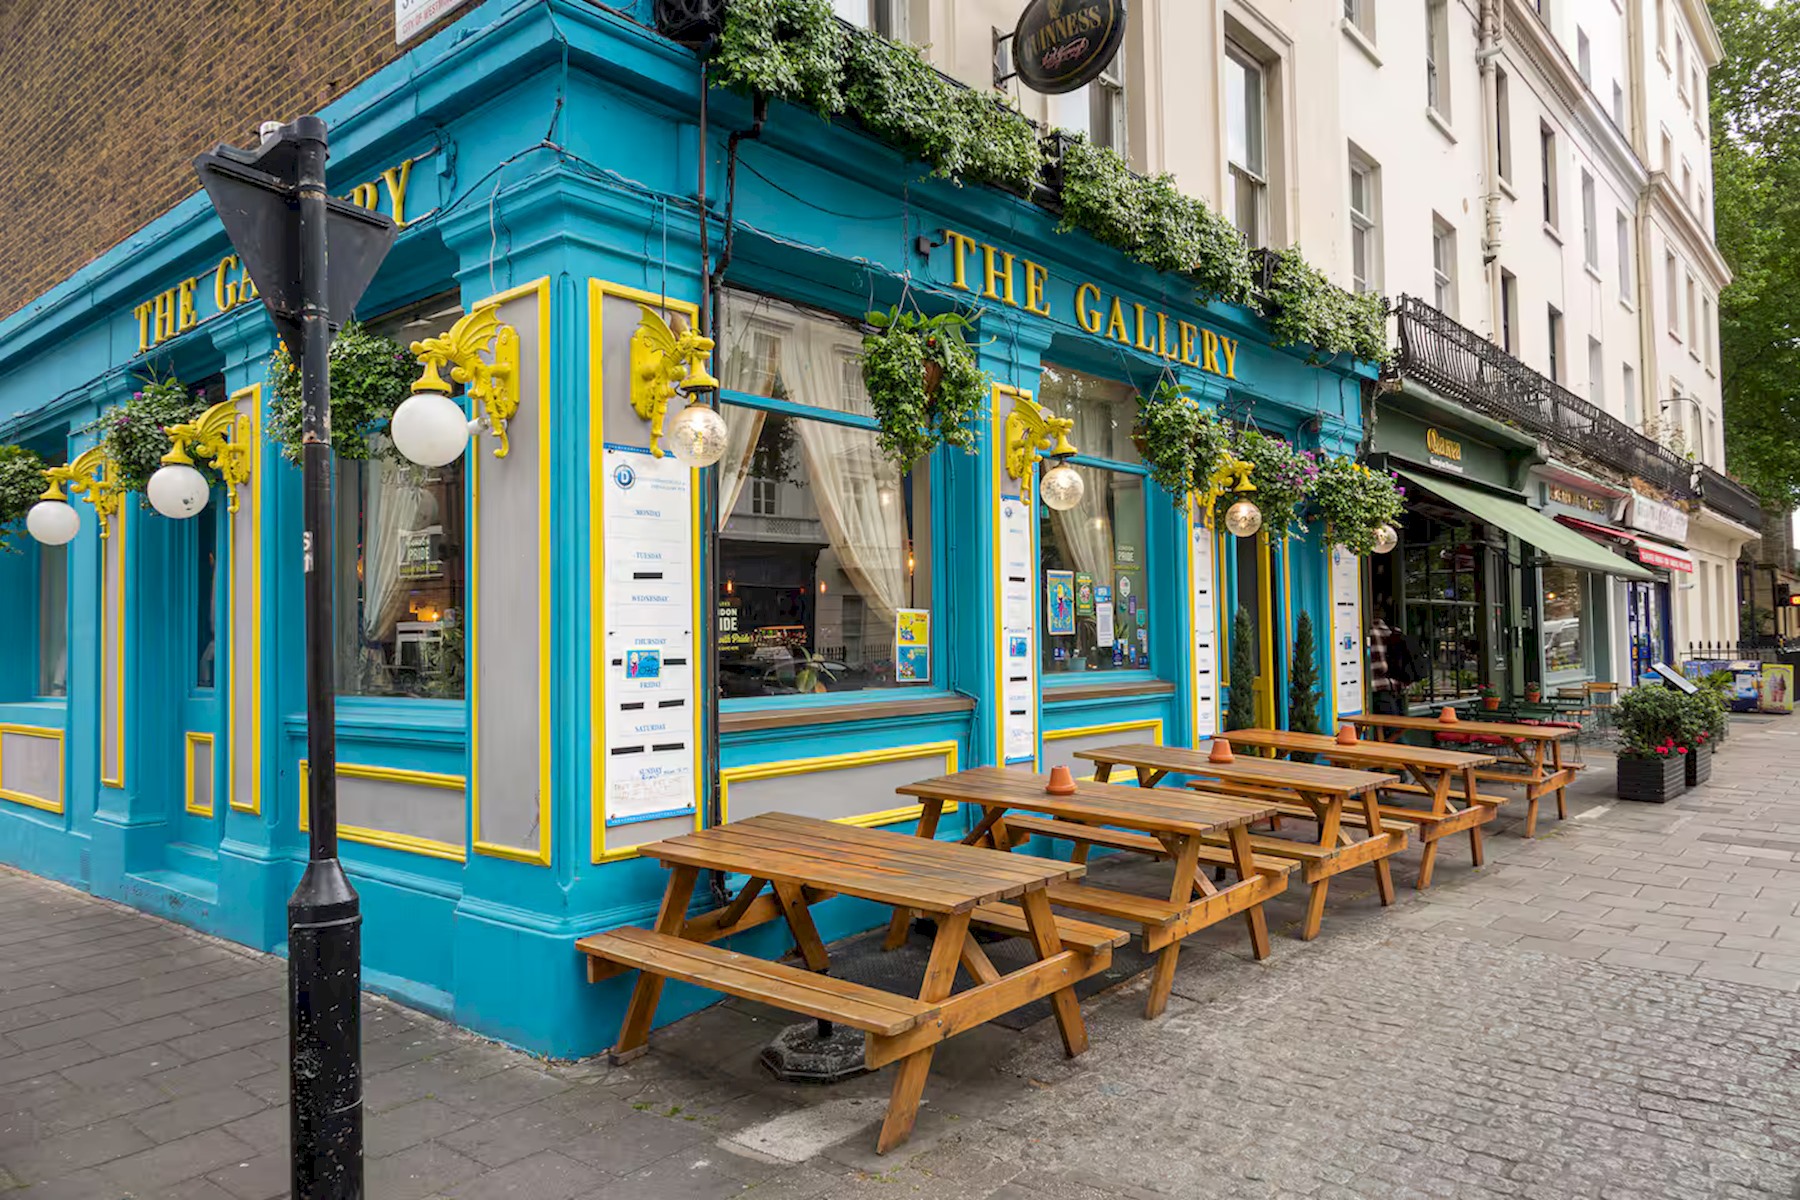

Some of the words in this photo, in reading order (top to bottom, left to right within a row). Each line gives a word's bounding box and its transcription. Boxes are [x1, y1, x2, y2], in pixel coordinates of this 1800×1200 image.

[131, 276, 198, 353] THE
[944, 229, 1051, 318] THE
[1075, 282, 1239, 380] GALLERY
[635, 724, 666, 732] SATURDAY
